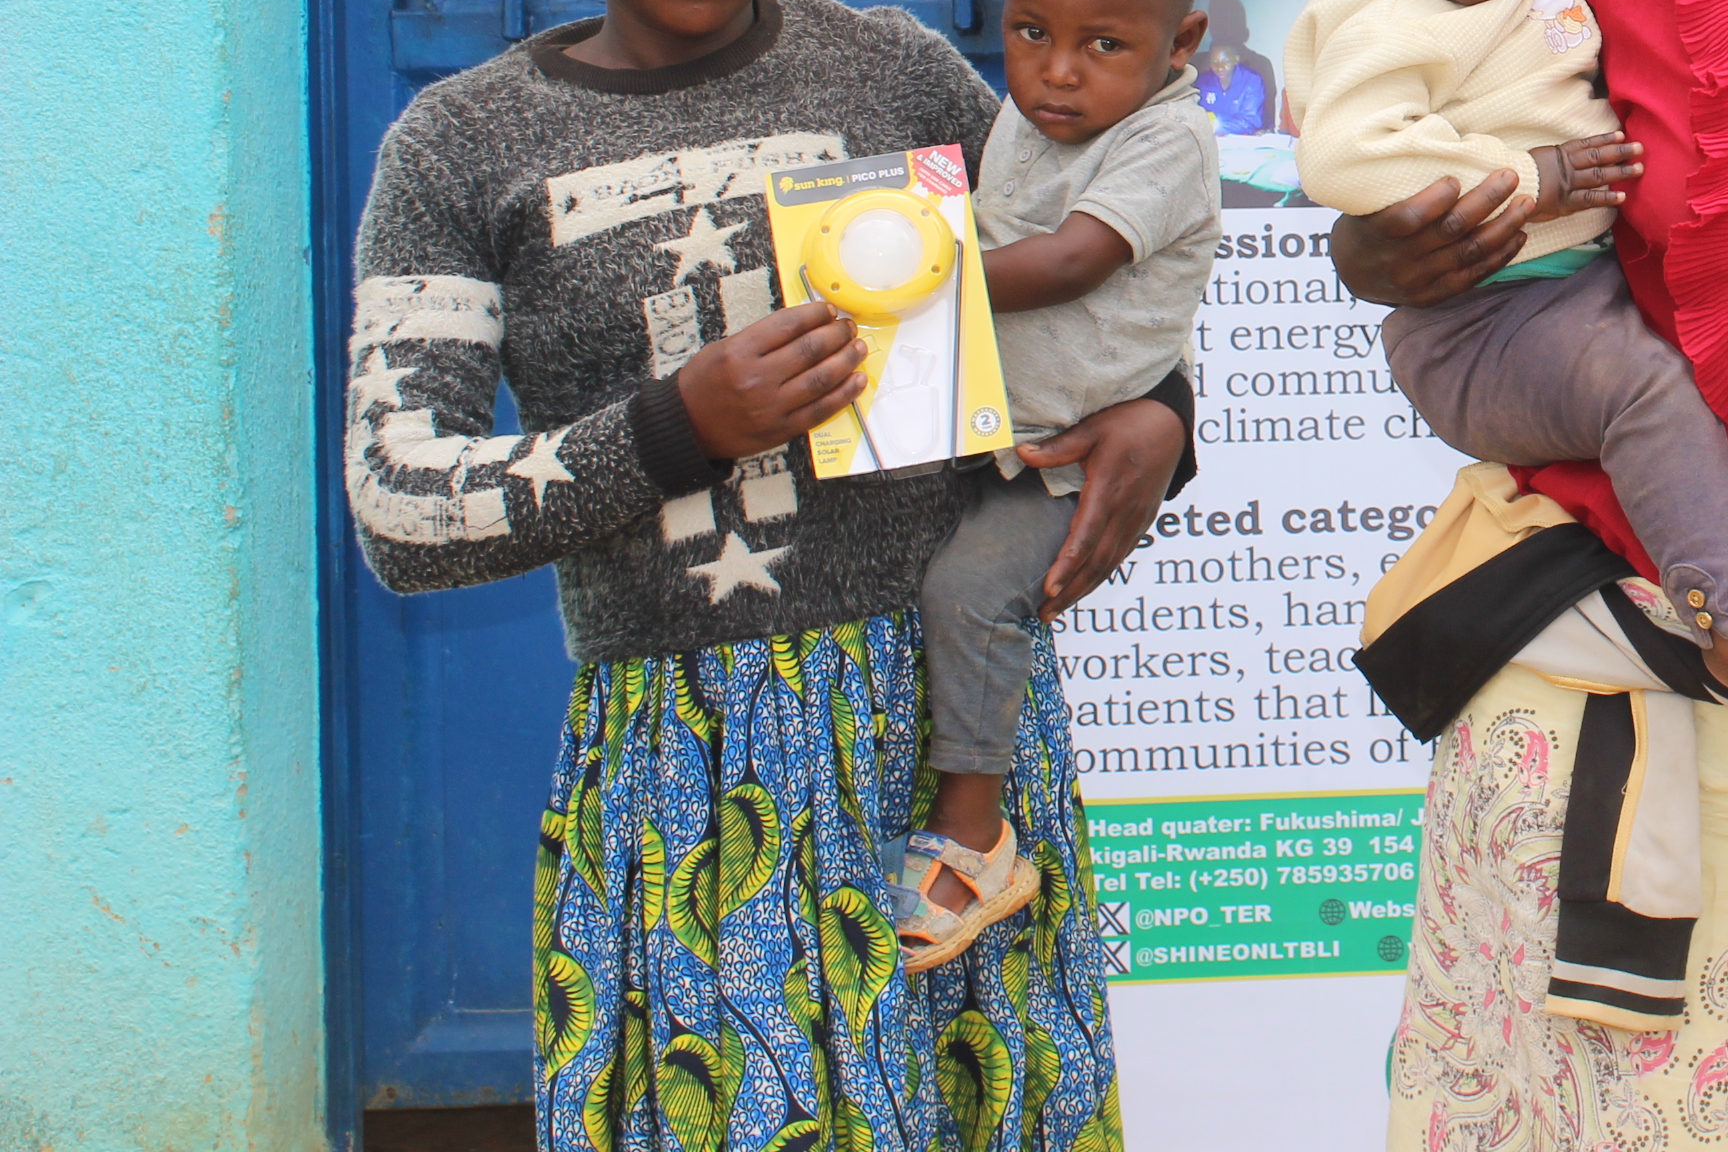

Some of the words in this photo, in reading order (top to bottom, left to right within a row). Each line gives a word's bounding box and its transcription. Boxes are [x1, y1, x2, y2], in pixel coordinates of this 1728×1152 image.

[922, 157, 963, 188] IMPROVED
[929, 149, 963, 176] NEW
[793, 178, 816, 191] sun
[851, 170, 877, 183] PICO
[878, 166, 905, 179] PLUS
[1230, 323, 1382, 359] energy
[1226, 369, 1399, 397] commu
[980, 413, 991, 426] 2
[1198, 407, 1366, 444] climate
[815, 438, 851, 447] CHARGING
[1281, 500, 1438, 541] catego
[1154, 546, 1360, 586] mothers,
[1051, 595, 1264, 635] students,
[1254, 684, 1350, 722] that
[1369, 728, 1410, 764] of
[1088, 817, 1154, 838] Head
[1161, 816, 1252, 839] quater:
[1260, 808, 1403, 832] Fukushima/
[1090, 841, 1268, 869] kigali-Rwanda
[1276, 838, 1314, 858] KG
[1322, 837, 1354, 857] 39
[1368, 835, 1415, 855] 154
[1093, 873, 1127, 892] Tel
[1134, 871, 1181, 891] Tel:
[1189, 867, 1269, 893] (+250)
[1276, 862, 1415, 887] 785935706
[1348, 900, 1416, 920] Webs
[1135, 940, 1341, 968] @SHINEONLTBLI
